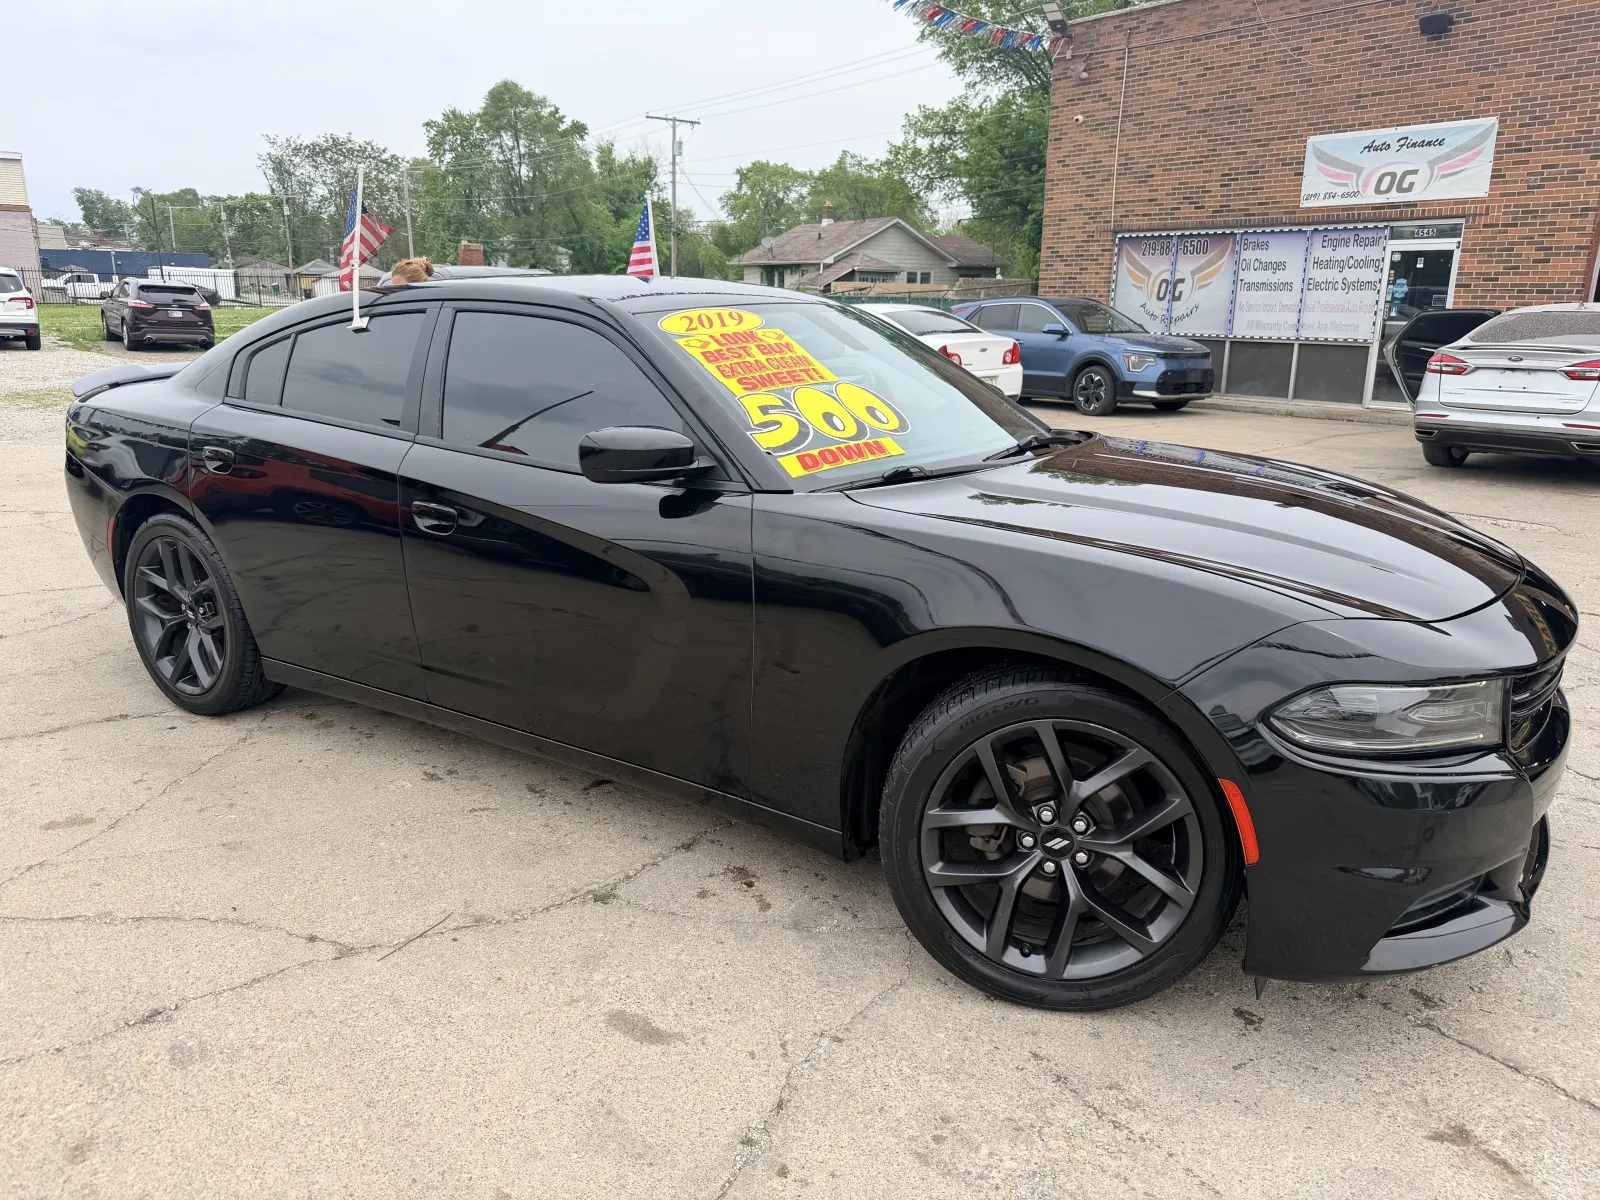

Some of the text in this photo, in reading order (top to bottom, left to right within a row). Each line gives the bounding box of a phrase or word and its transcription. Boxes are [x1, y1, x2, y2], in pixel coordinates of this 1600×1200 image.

[1360, 136, 1446, 154] Auto Finance
[1374, 169, 1419, 195] OG
[1302, 193, 1321, 201] (219)
[1415, 229, 1436, 237] 4545
[1242, 238, 1270, 251] Brakes
[1321, 233, 1382, 251] Engine Repair
[1240, 258, 1287, 274] Oil Changes
[1312, 256, 1381, 273] Heating/Cooling
[1239, 278, 1294, 292] Transmissions
[1307, 277, 1339, 292] Electric
[1340, 277, 1378, 294] Systems
[1140, 302, 1158, 321] Auto
[1245, 301, 1262, 313] Service
[1316, 300, 1346, 313] Professional
[1346, 301, 1358, 313] Auto
[679, 311, 744, 332] 2019
[1246, 320, 1254, 331] All
[1255, 320, 1282, 333] Warranty
[1316, 321, 1328, 331] Are
[1329, 320, 1360, 332] Welcome
[708, 331, 767, 347] LOOK
[700, 341, 797, 364] BEST BUY
[715, 354, 816, 379] EXTRA CLEAN
[736, 367, 828, 392] SWEET!
[736, 382, 911, 456] 500
[796, 440, 890, 471] DOWN
